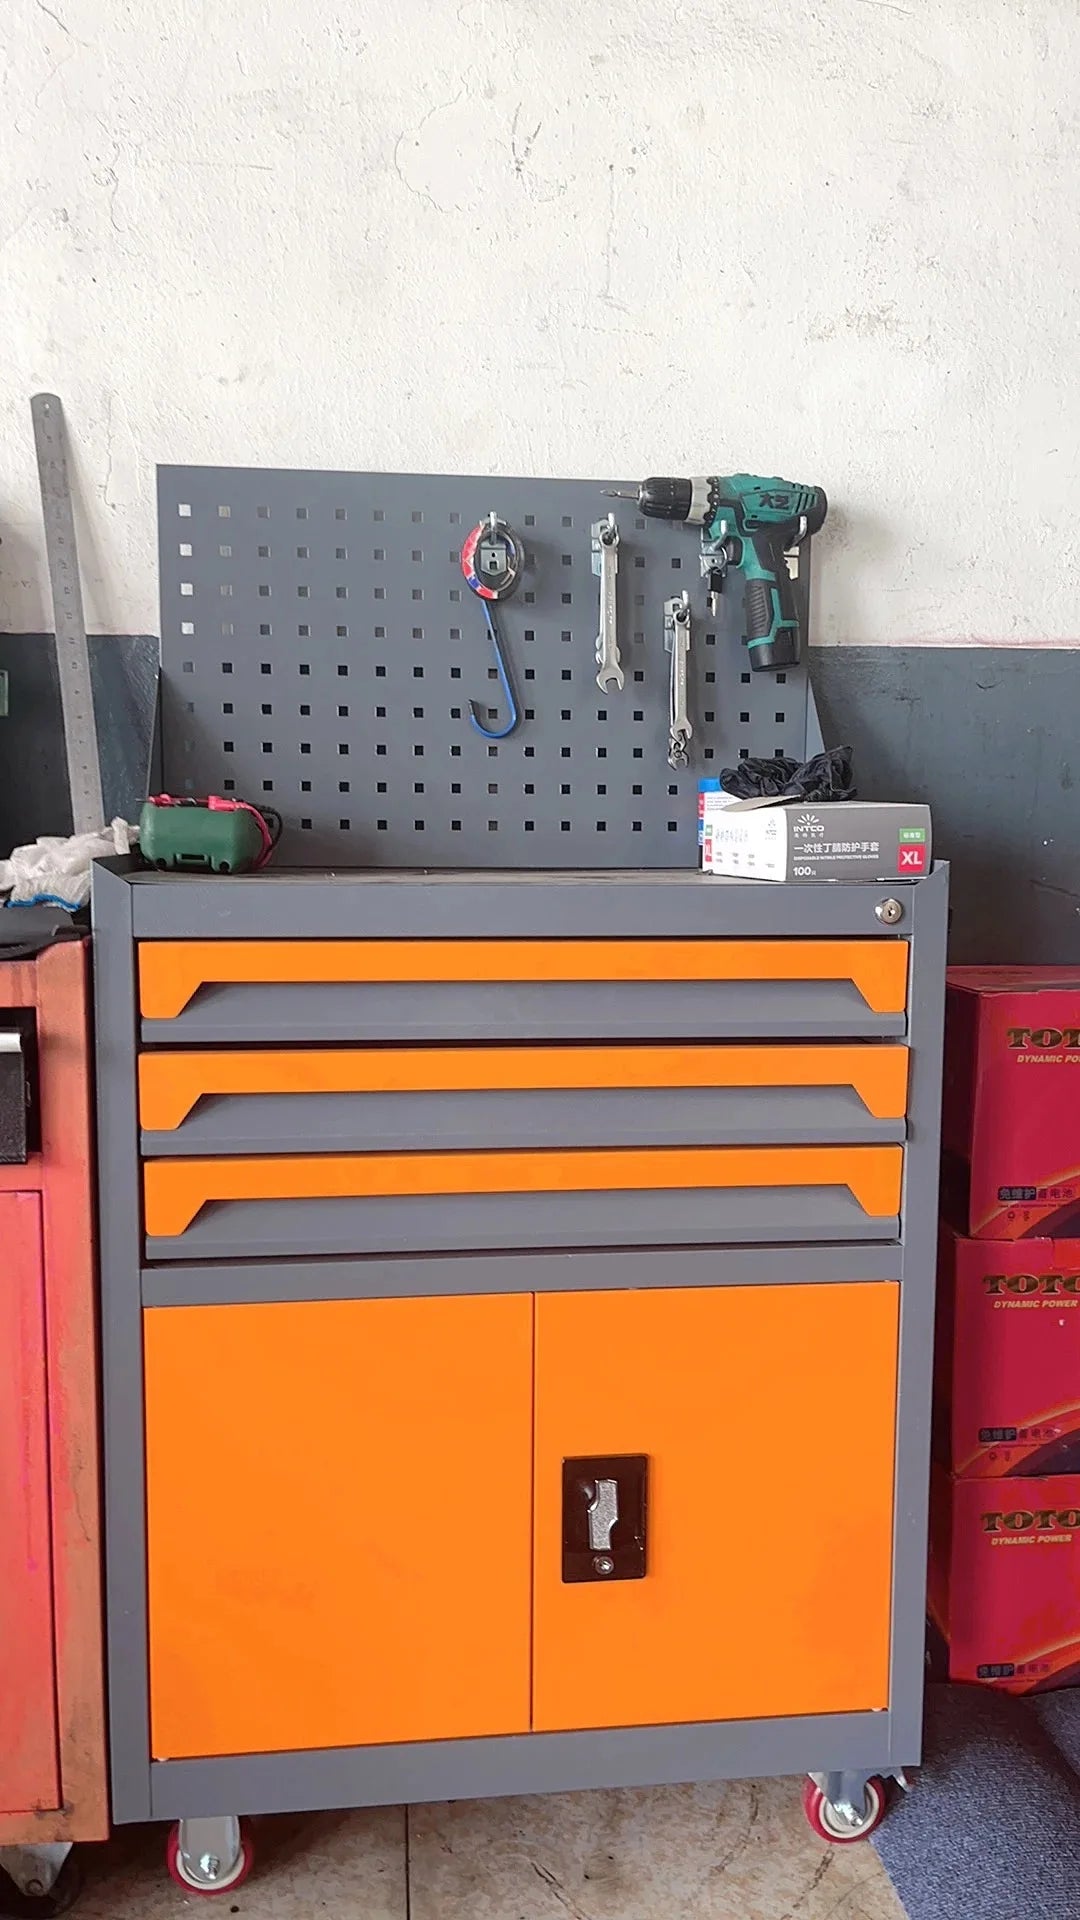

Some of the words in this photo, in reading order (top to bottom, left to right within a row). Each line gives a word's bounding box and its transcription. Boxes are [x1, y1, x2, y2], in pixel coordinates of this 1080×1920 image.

[901, 851, 922, 865] XL
[1017, 1055, 1063, 1063] DYNAMIC
[994, 1300, 1040, 1308] DYNAMIC
[1042, 1300, 1078, 1308] POWER
[982, 1508, 1080, 1533] TOTO
[991, 1536, 1036, 1545] DYNAMIC
[1037, 1534, 1072, 1543] POWER
